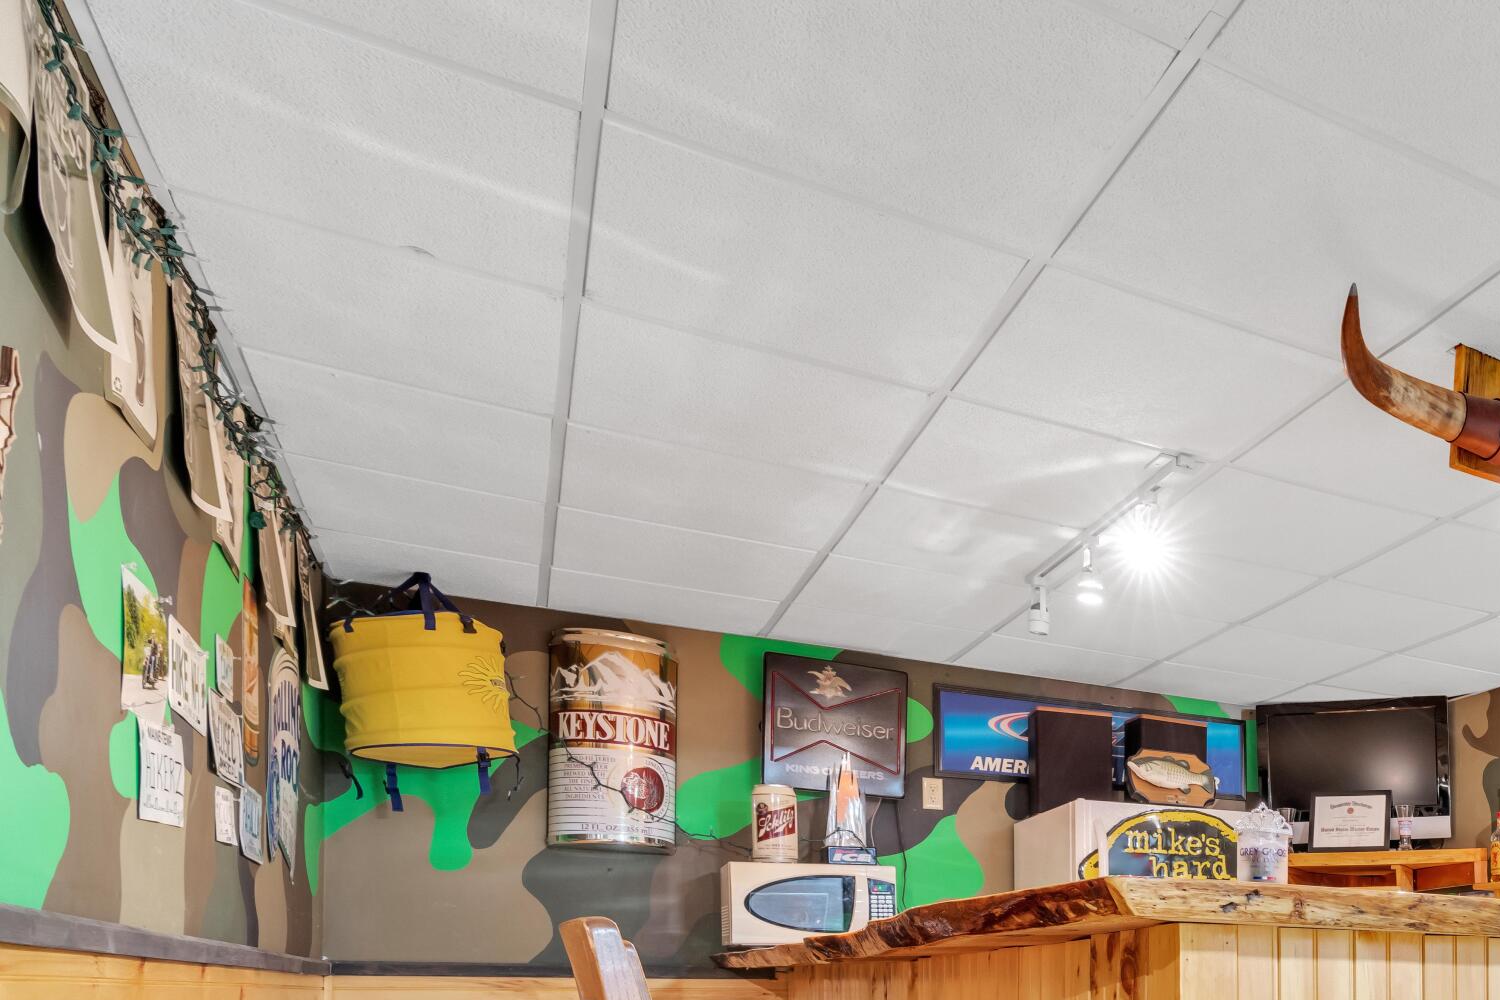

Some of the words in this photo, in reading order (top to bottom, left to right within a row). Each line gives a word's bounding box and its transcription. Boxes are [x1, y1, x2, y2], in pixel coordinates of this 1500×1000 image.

[273, 680, 301, 751] ROLLING
[558, 711, 670, 750] KEYSTONE
[776, 706, 895, 740] Budweiser
[785, 763, 820, 776] KING
[1123, 826, 1221, 857] mike's
[832, 853, 871, 863] ICE
[1148, 854, 1232, 880] hard
